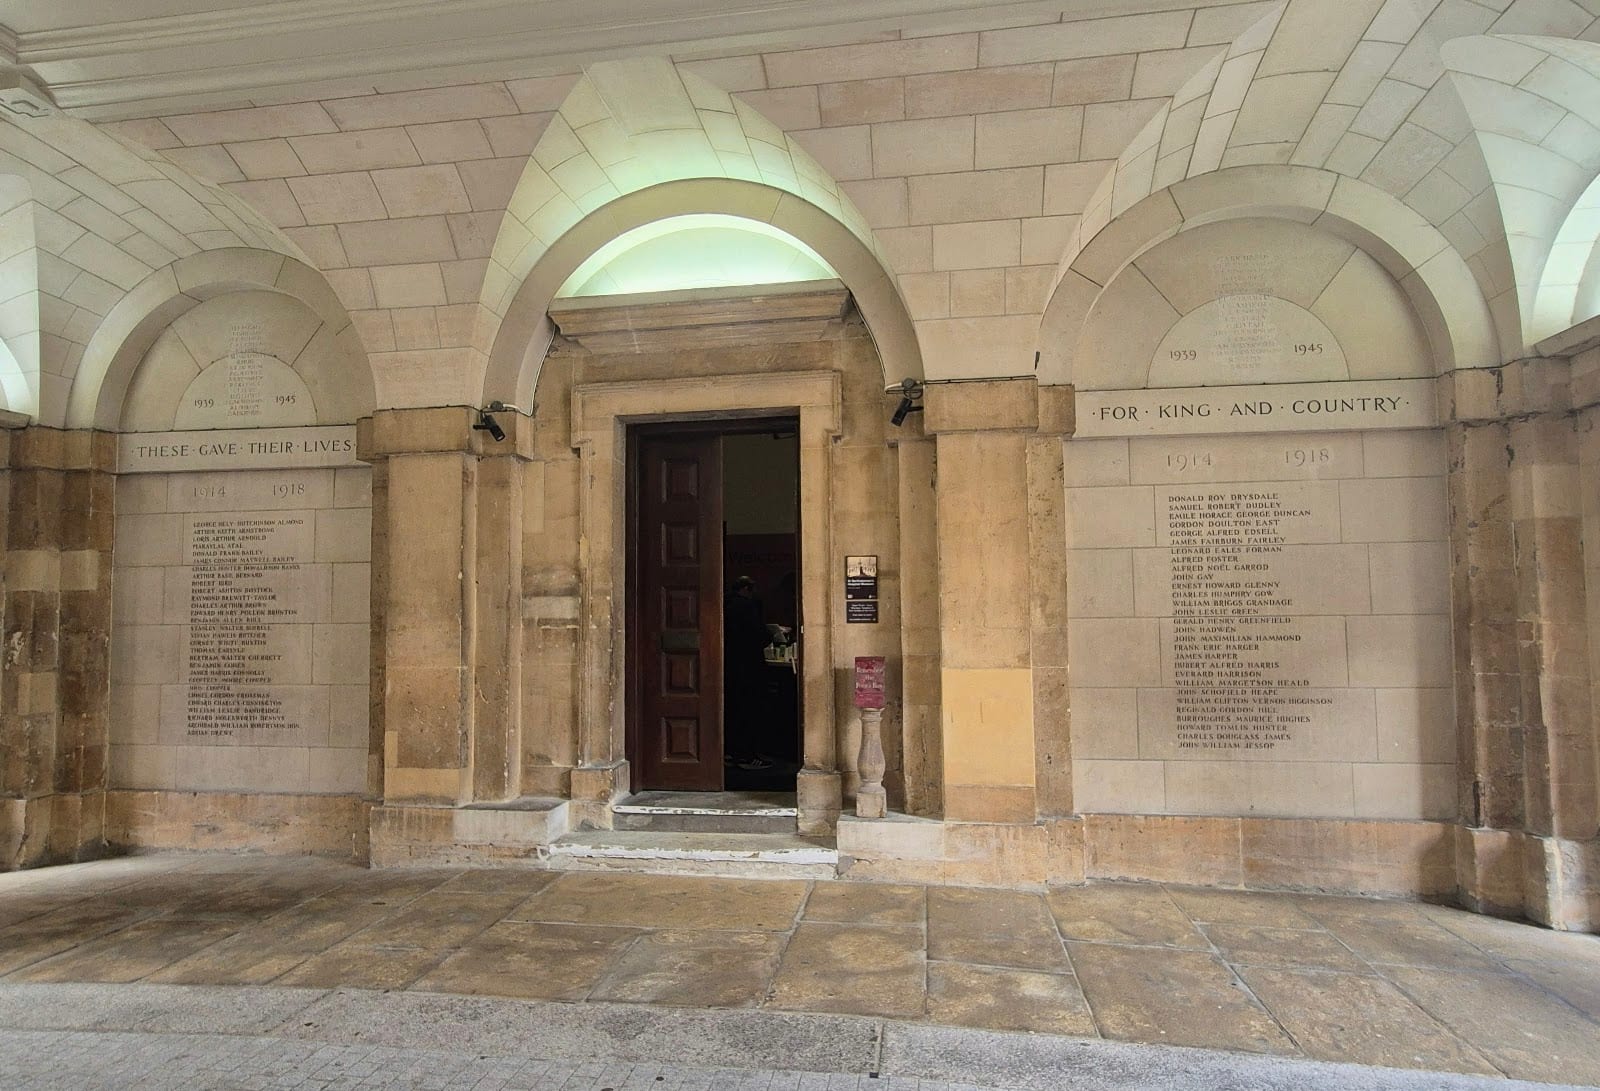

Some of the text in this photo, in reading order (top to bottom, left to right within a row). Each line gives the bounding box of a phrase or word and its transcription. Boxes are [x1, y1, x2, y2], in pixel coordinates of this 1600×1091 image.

[1169, 350, 1197, 361] 1939
[1294, 344, 1322, 355] 1945
[194, 399, 214, 408] 1939
[276, 395, 296, 405] 1945
[1100, 397, 1401, 422] FOR KING AND COUNTRY
[138, 439, 351, 458] THESE GAVE THEIR LIVES
[1167, 453, 1212, 471] 1914
[1285, 449, 1329, 467] 1918
[194, 486, 226, 498] 1914
[273, 484, 305, 498] 1918
